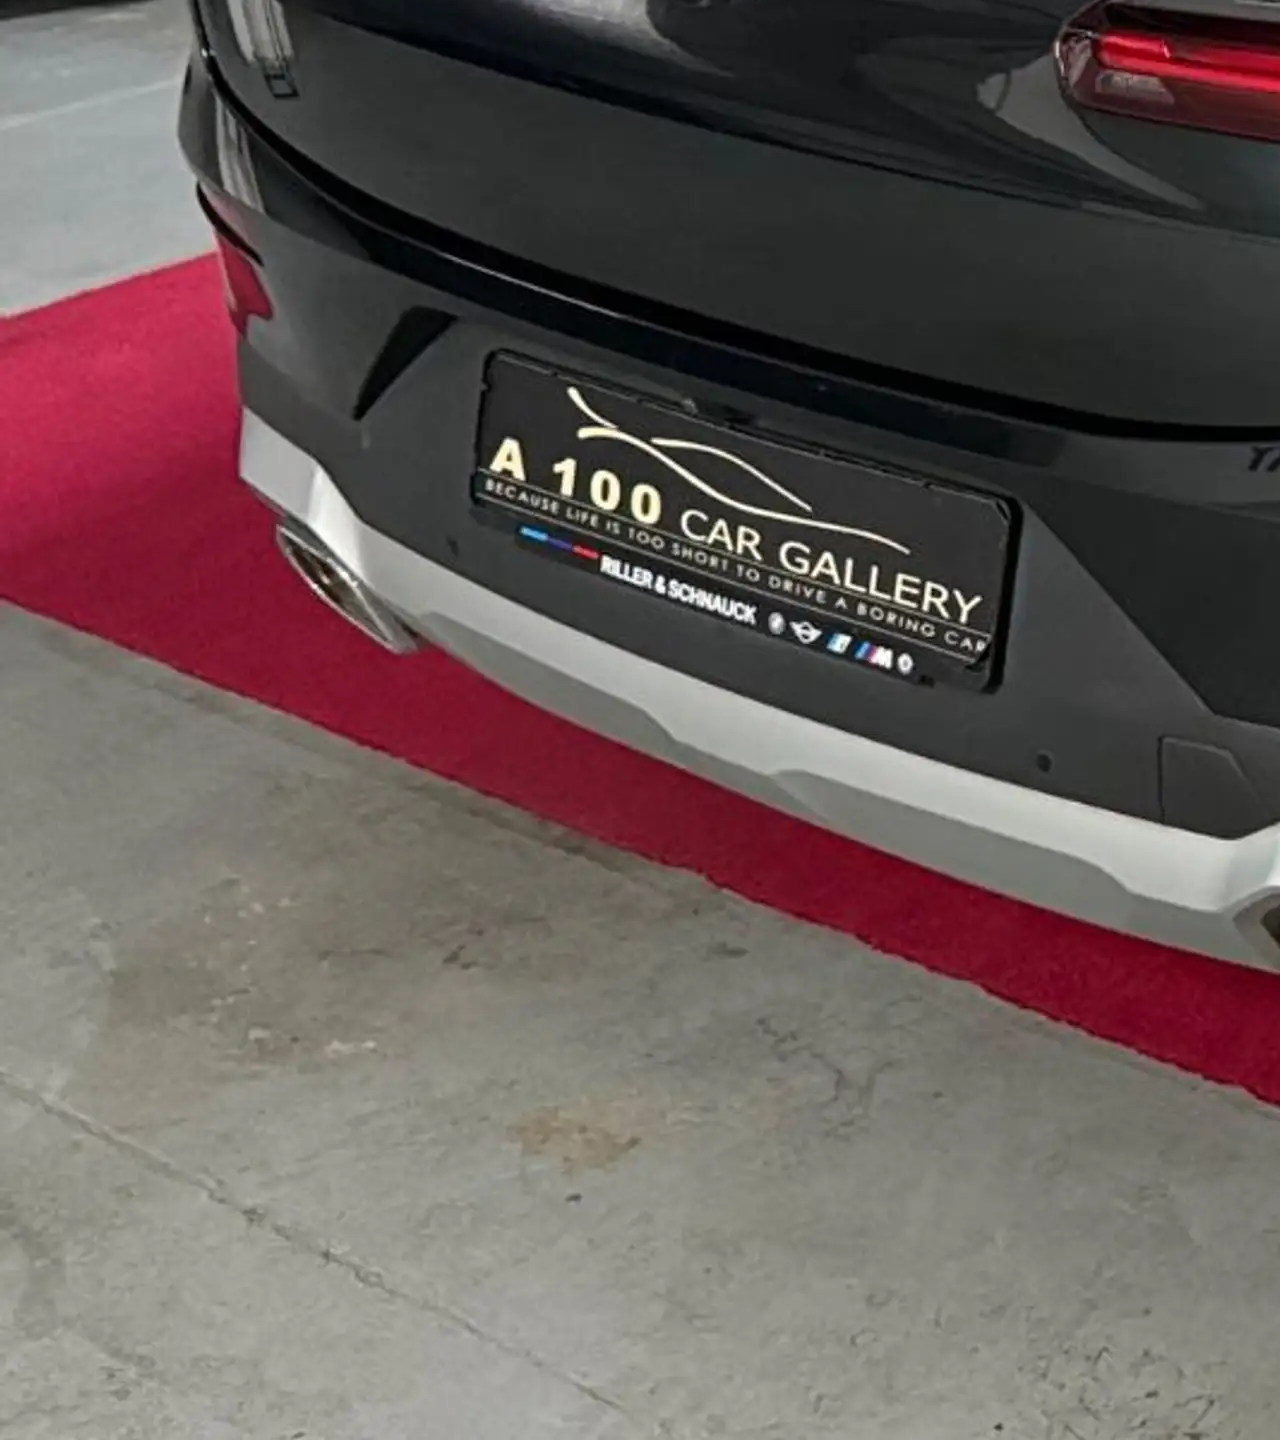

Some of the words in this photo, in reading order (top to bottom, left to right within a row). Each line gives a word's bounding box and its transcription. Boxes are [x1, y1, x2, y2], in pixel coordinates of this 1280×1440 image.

[485, 478, 560, 515] BECAUSE
[565, 508, 599, 529] LIFE
[605, 519, 620, 536] IS
[628, 527, 665, 550] TOO
[671, 541, 729, 573] SHORT
[736, 563, 760, 583] TO
[768, 576, 827, 604] DRIVE
[835, 597, 849, 611] A
[856, 603, 936, 639] BORING
[943, 632, 989, 653] CAR
[489, 436, 526, 482] A
[552, 457, 662, 525] 100
[680, 509, 764, 562] CAR
[779, 541, 982, 625] GALLERY
[600, 555, 653, 591] RILLER
[654, 576, 667, 594] &
[668, 580, 758, 625] SCHNAUCK
